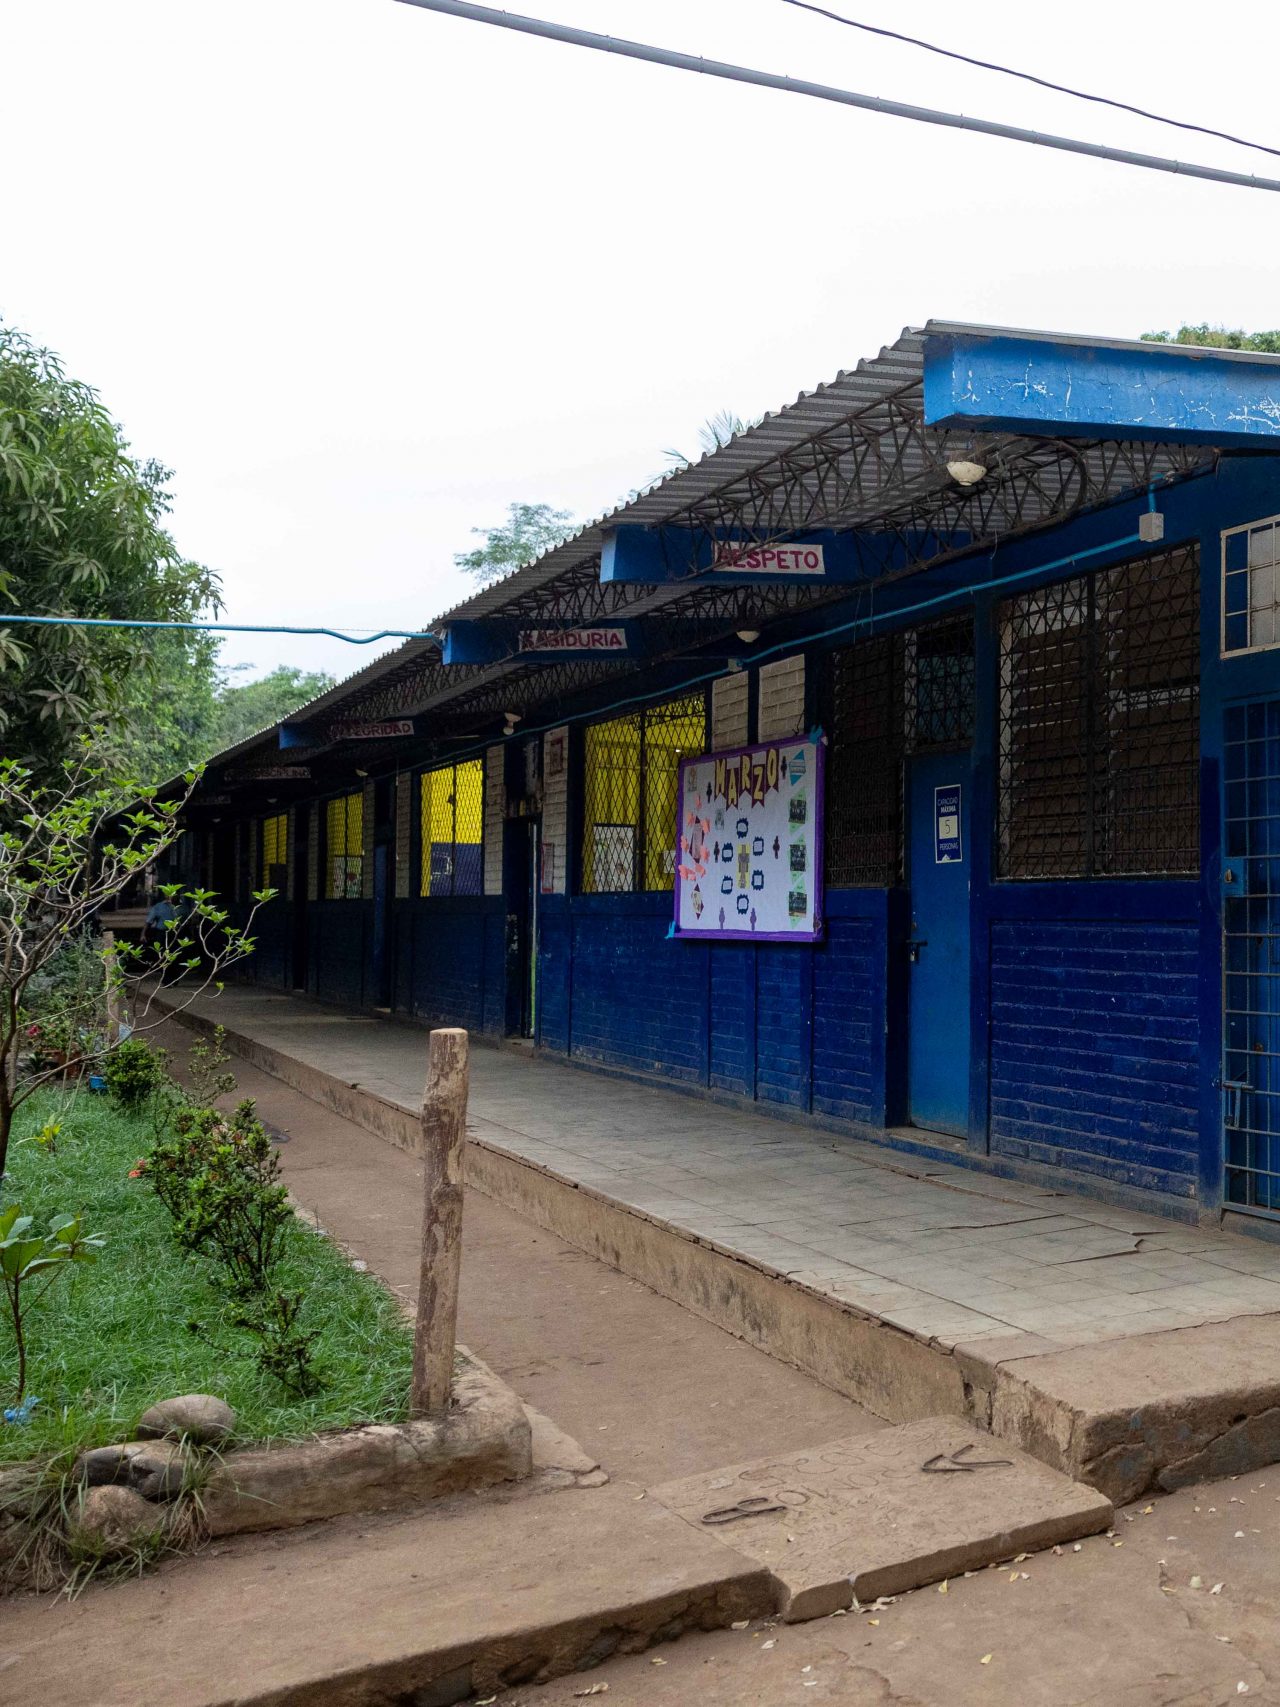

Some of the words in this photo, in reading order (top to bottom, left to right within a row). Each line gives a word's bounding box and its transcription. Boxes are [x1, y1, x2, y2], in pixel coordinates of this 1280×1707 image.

[717, 549, 819, 569] RESPETO
[715, 750, 778, 805] MARZO
[945, 820, 951, 834] 5
